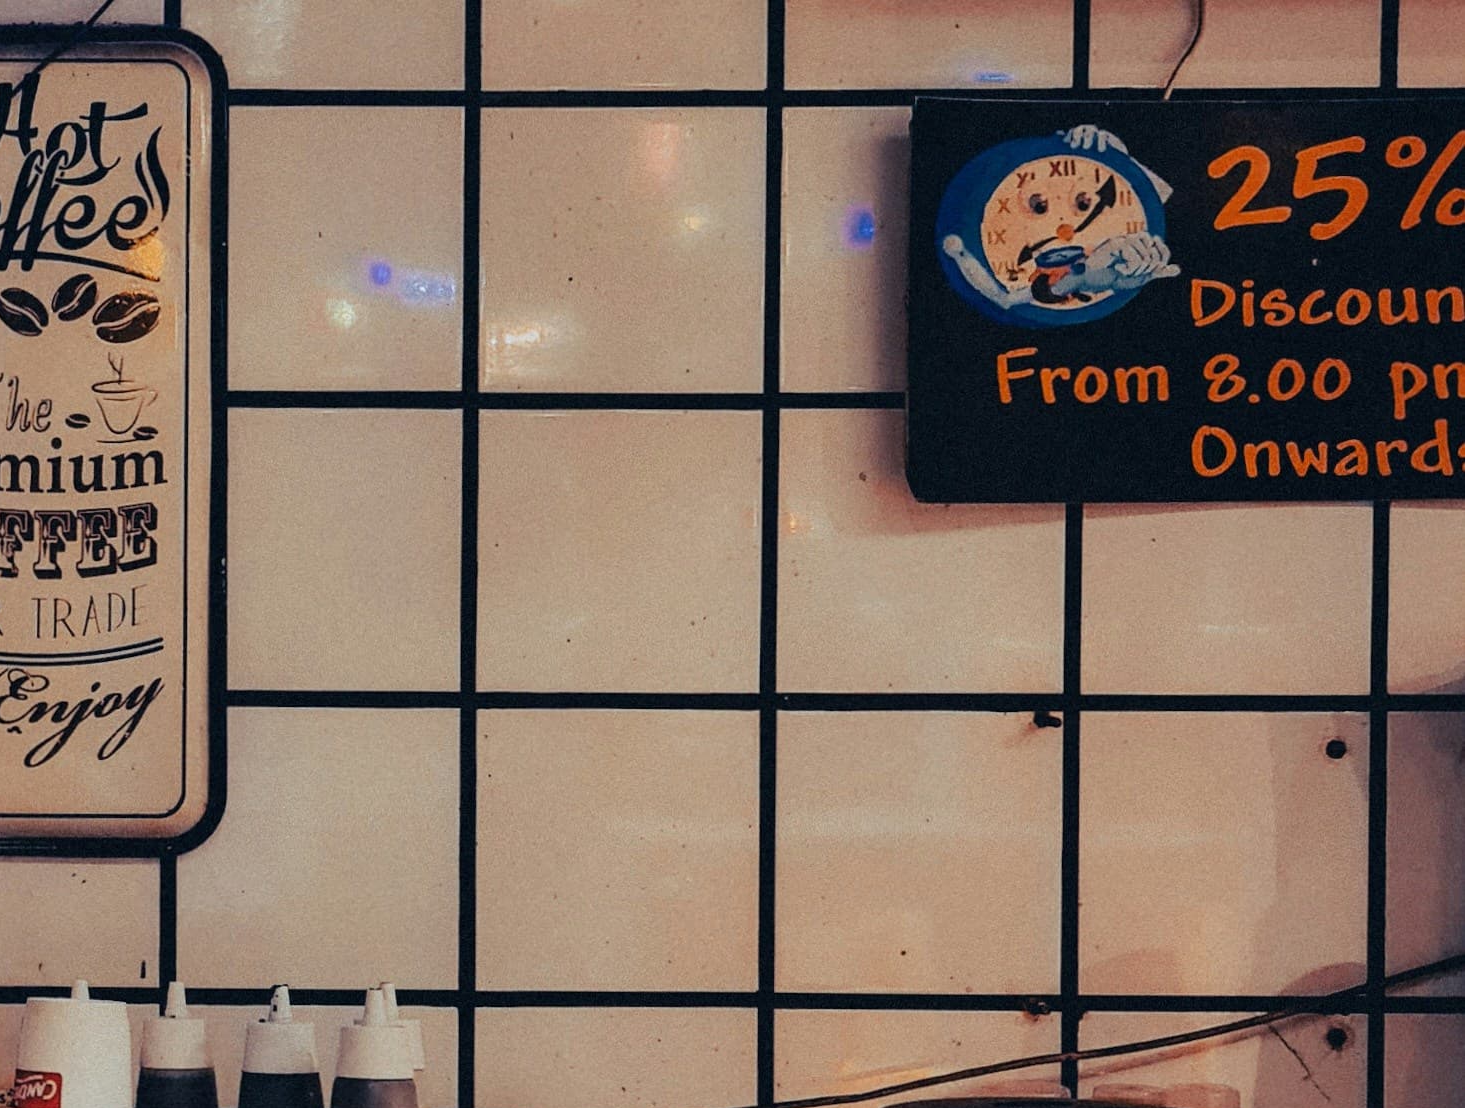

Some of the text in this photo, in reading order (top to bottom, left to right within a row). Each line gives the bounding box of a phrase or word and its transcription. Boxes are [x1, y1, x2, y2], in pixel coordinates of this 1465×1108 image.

[1207, 131, 1465, 240] 25%
[1191, 279, 1465, 327] Discoun
[997, 347, 1169, 404] From
[1203, 353, 1351, 403] 8.00
[32, 584, 147, 638] TRADE
